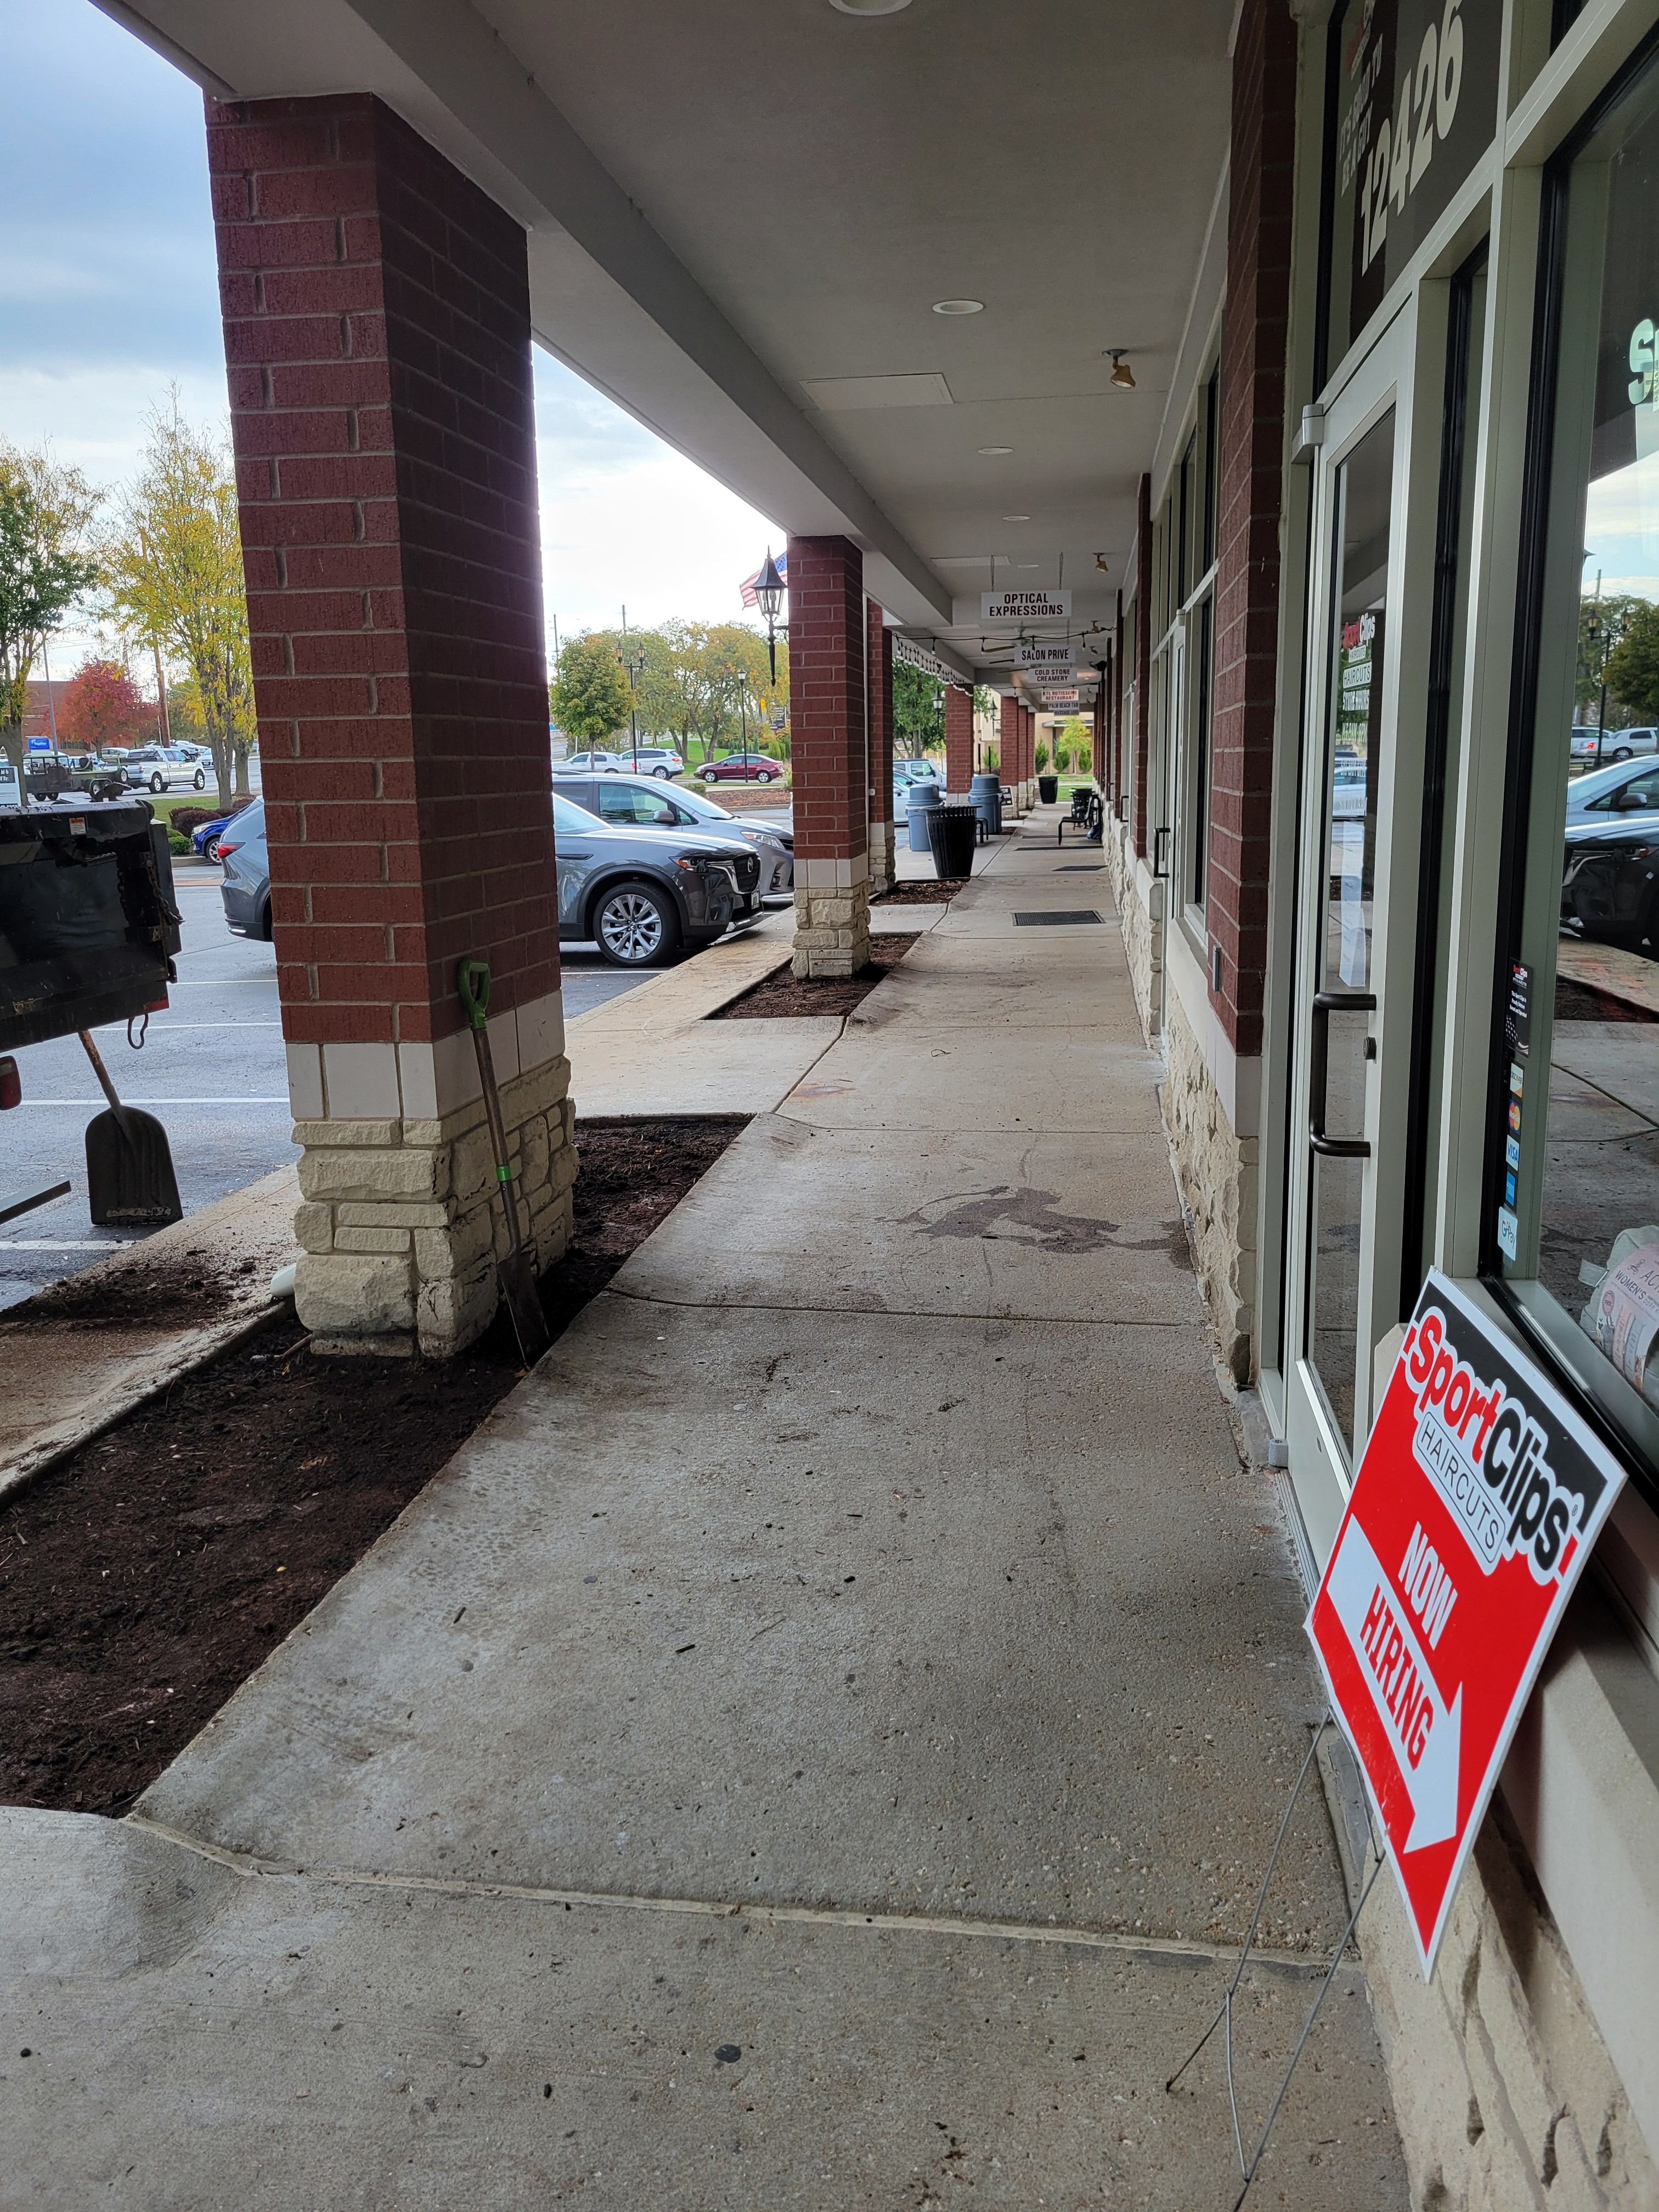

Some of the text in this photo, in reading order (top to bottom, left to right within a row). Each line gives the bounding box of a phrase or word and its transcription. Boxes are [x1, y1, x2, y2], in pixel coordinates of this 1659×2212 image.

[1361, 0, 1463, 277] 12426
[989, 605, 1063, 616] EXPRESSIONS
[1005, 593, 1048, 603] OPTICAL
[1022, 649, 1069, 661] SALON PRIVE
[1344, 665, 1370, 686] HAIRCUTS
[1508, 1143, 1518, 1164] VISA
[1615, 1270, 1646, 1300] WOMEN'S
[1421, 1421, 1499, 1549] HAIRCUTS
[1398, 1521, 1458, 1651] NOW
[1359, 1583, 1434, 1771] HIRING
